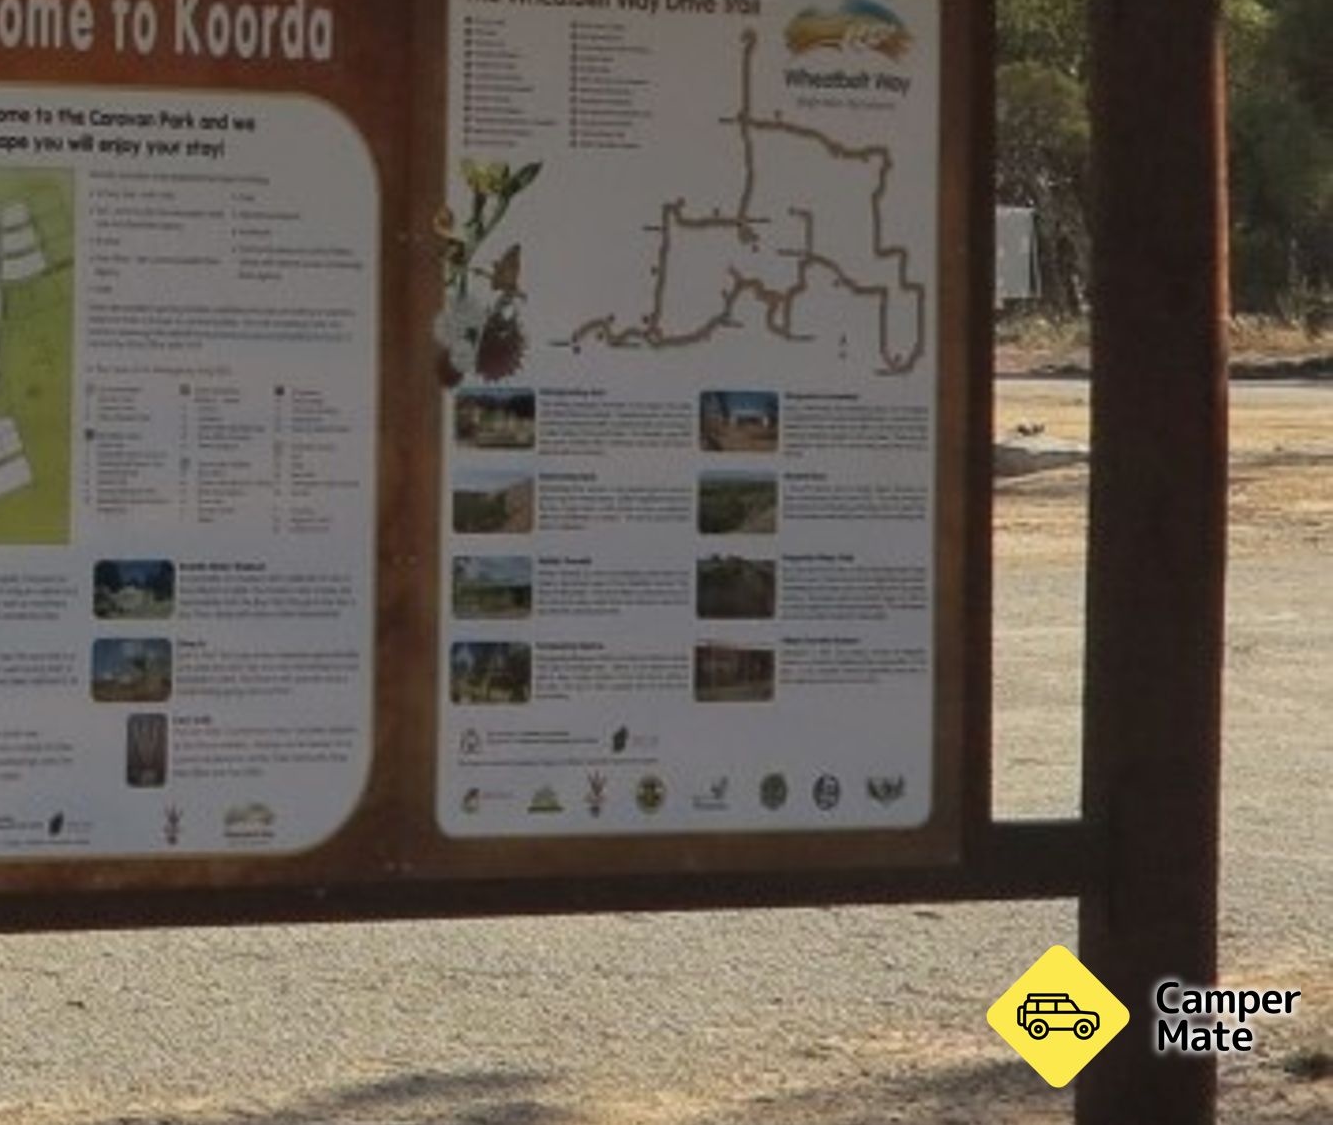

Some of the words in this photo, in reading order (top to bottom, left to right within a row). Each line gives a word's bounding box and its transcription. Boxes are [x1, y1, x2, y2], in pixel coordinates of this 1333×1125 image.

[784, 68, 869, 90] Wheatbelt
[875, 73, 911, 96] Way
[36, 106, 54, 125] to
[58, 106, 85, 126] the
[89, 108, 156, 129] Caravan
[160, 109, 195, 130] Park
[199, 111, 228, 131] and
[232, 116, 256, 132] we
[33, 137, 65, 155] you
[68, 134, 94, 153] will
[100, 136, 141, 157] enjoy
[145, 140, 181, 158] your
